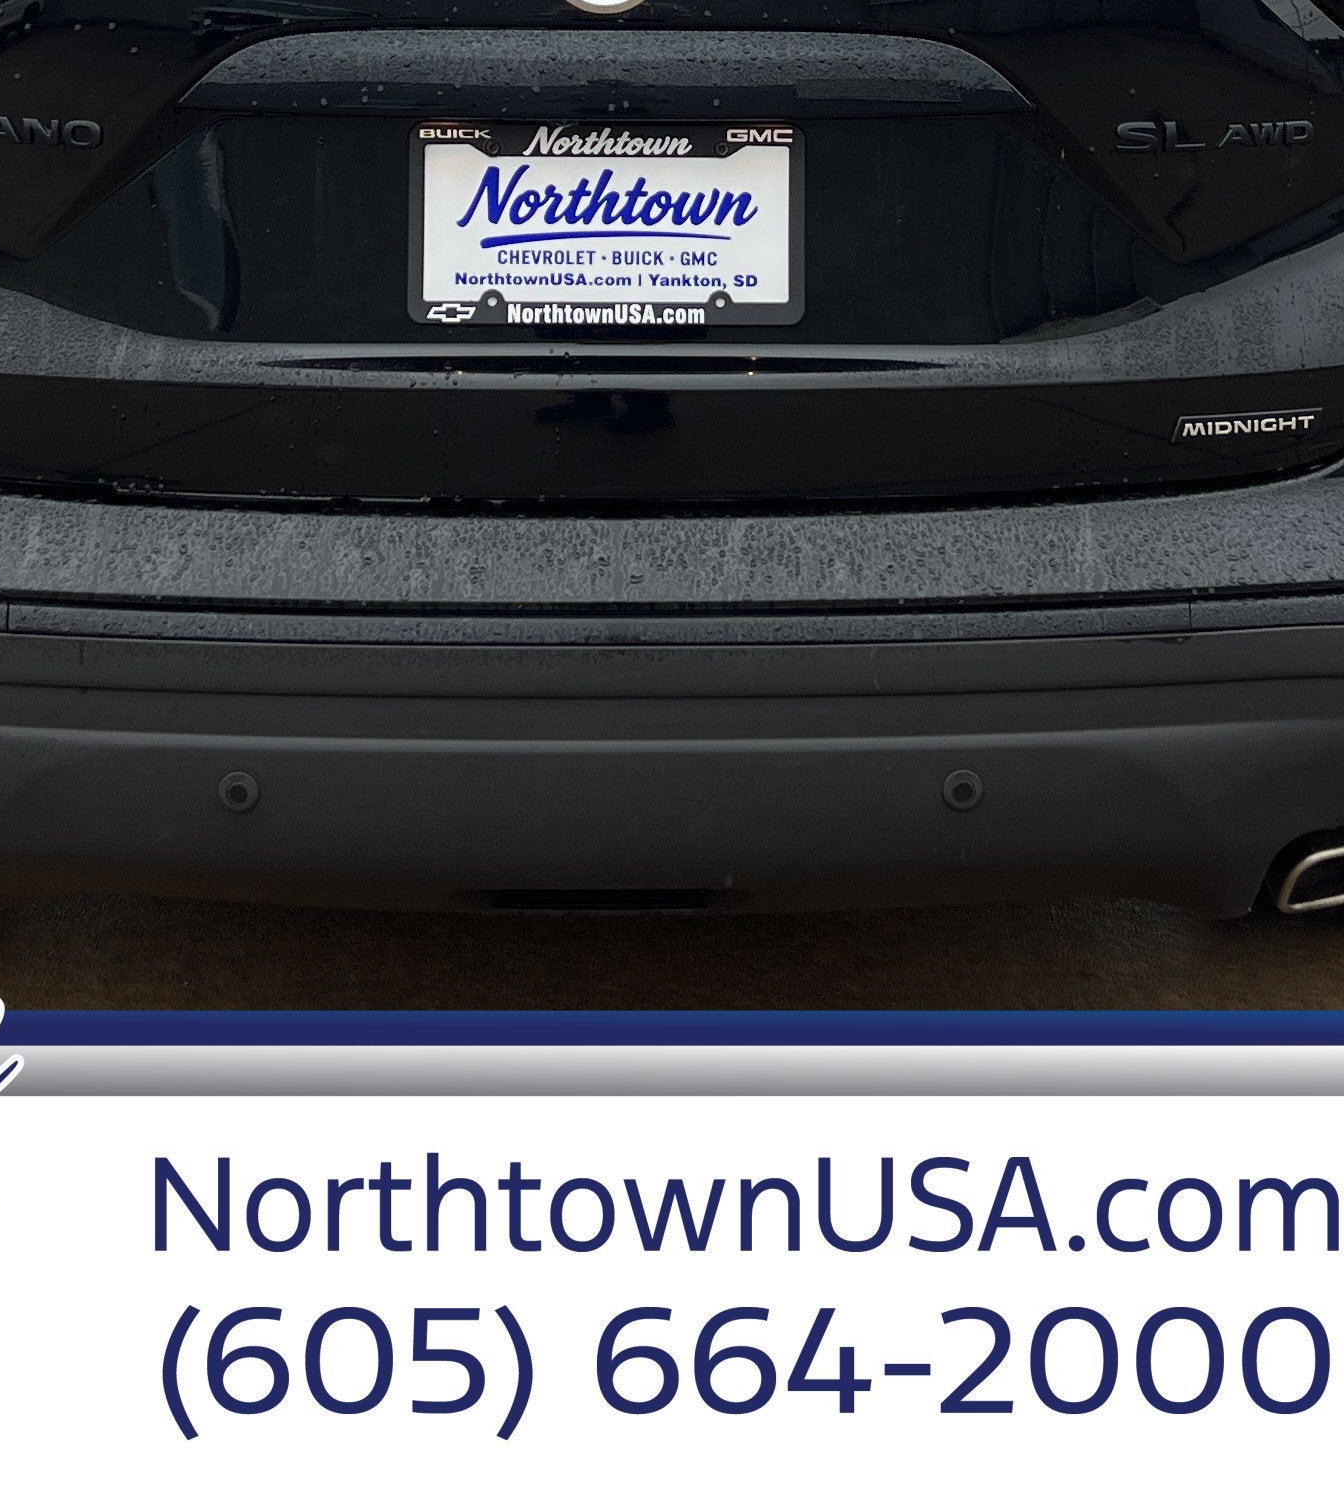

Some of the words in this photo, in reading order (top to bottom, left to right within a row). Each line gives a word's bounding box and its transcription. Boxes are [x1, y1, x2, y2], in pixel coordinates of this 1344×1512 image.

[418, 128, 492, 139] BUICK
[522, 126, 692, 157] Northtown
[725, 128, 794, 143] GMC
[1114, 120, 1206, 152] SL
[1216, 120, 1316, 146] AWD
[456, 164, 759, 227] Northtown
[497, 250, 597, 266] CHEVROLET
[611, 250, 664, 266] BUICK
[680, 250, 718, 266] GMC
[455, 272, 632, 287] NorthtownUSA.com
[648, 273, 727, 289] Yankton,
[733, 273, 758, 288] SD
[507, 303, 705, 325] NorthtownUSA.com
[1182, 414, 1316, 437] MIDNIGHT
